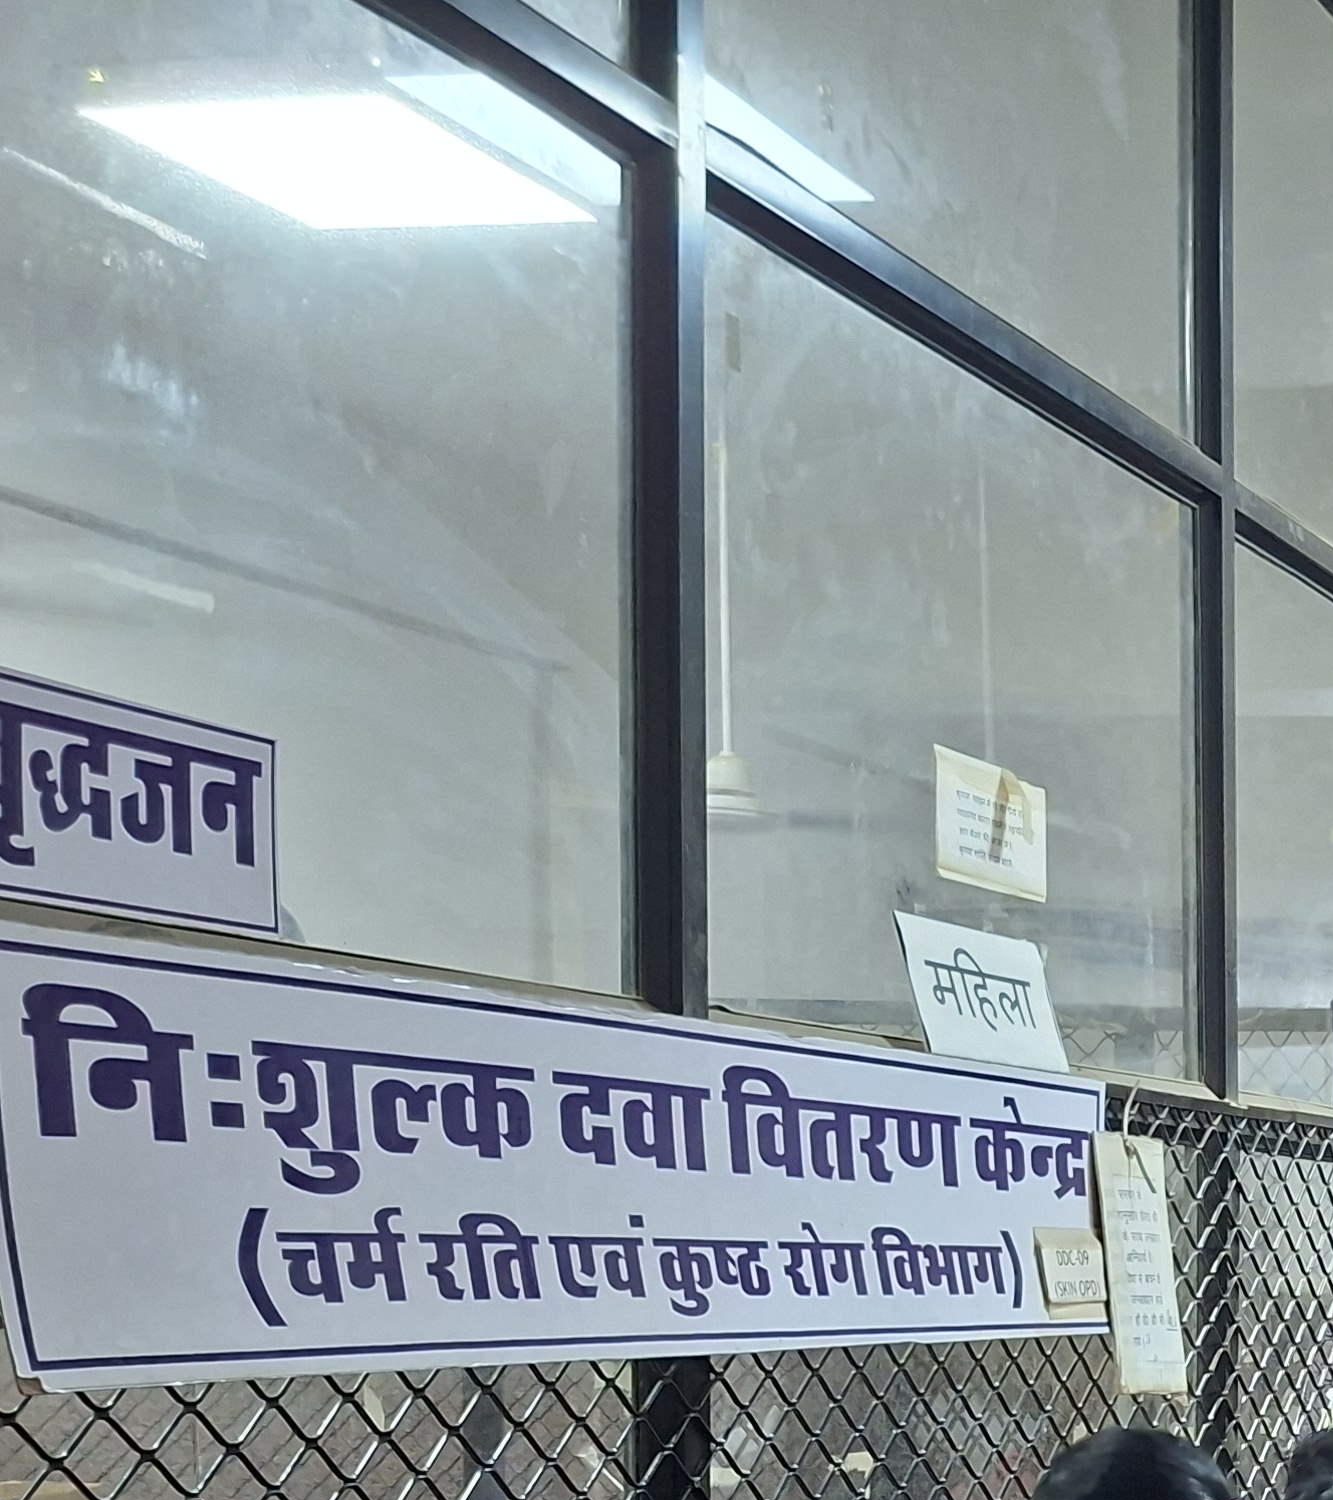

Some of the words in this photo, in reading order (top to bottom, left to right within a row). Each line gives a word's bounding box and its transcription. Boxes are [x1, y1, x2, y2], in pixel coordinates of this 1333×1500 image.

[924, 948, 1036, 1032] महिला
[552, 1070, 710, 1171] दवा
[721, 1065, 961, 1187] वितरण
[969, 1096, 1089, 1199] केन्द्र
[236, 1207, 407, 1327] (चर्म
[418, 1213, 541, 1300] रति
[548, 1214, 647, 1299] एवं
[652, 1238, 772, 1317] कुष्ठ
[778, 1221, 866, 1297] रोग
[872, 1227, 1024, 1309] विभाग)
[1055, 1280, 1077, 1297] (SKIN
[1079, 1281, 1100, 1297] OPD)
[1056, 1250, 1089, 1266] DDC-09
